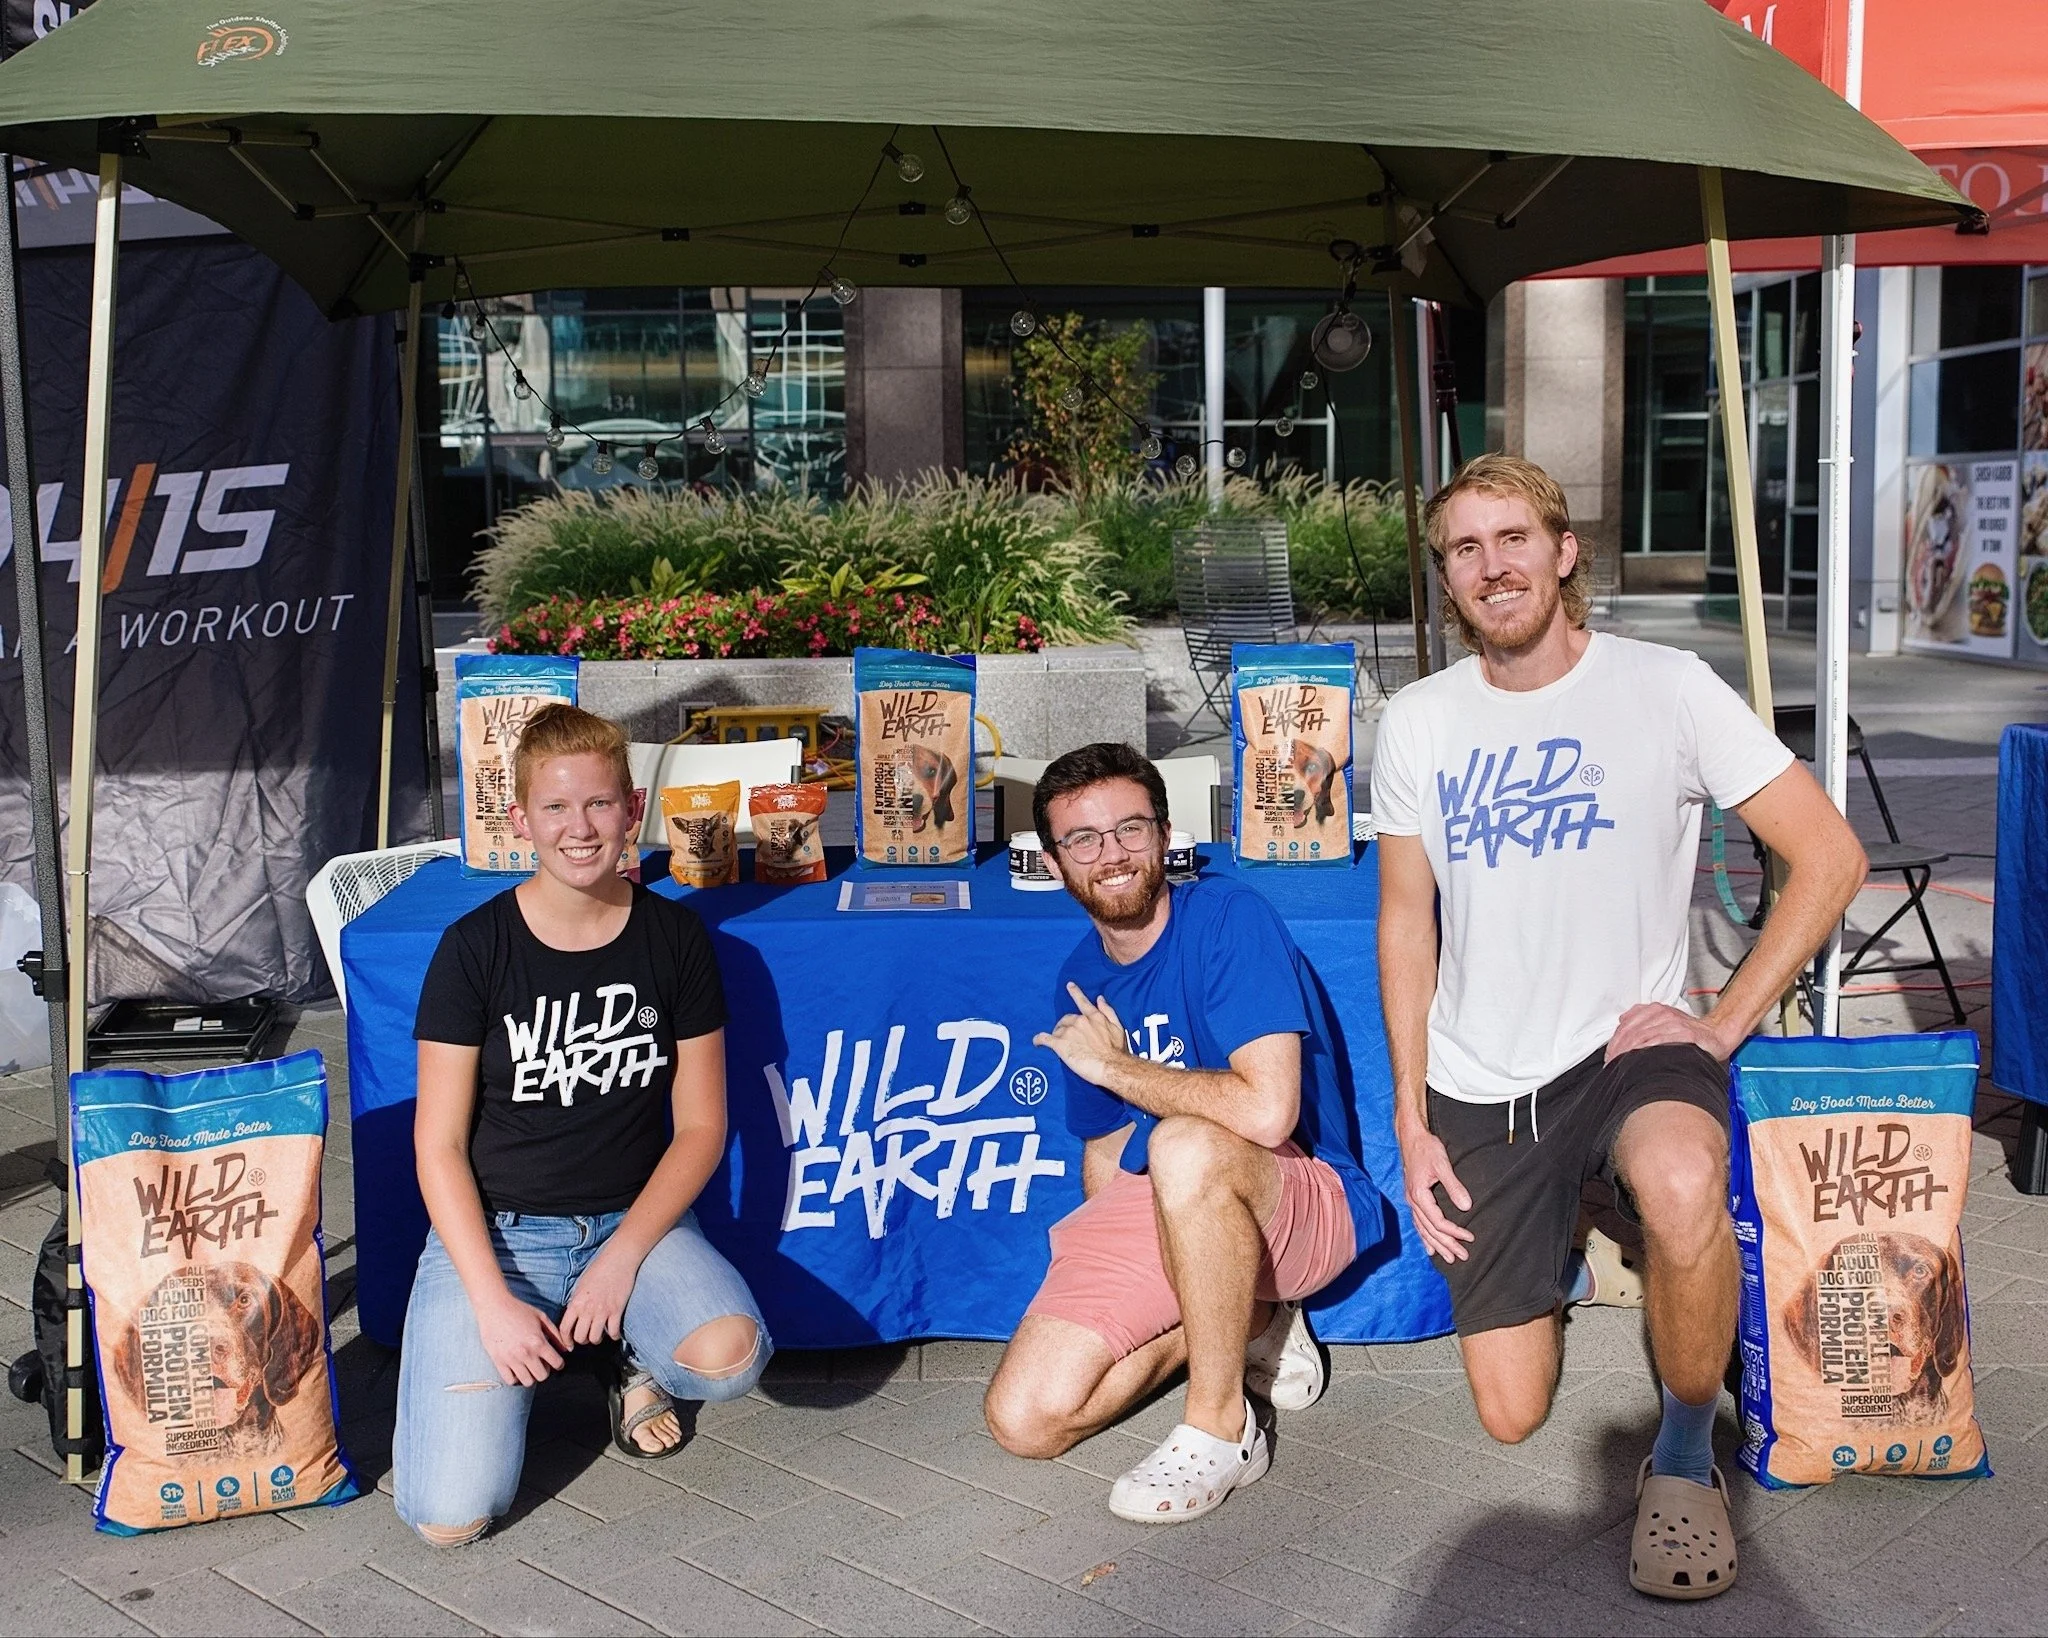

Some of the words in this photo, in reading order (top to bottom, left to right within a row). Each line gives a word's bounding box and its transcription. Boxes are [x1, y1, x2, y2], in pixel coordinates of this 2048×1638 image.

[219, 16, 253, 25] Outdoor
[255, 16, 281, 31] Shelter
[120, 594, 354, 649] WORKOUT
[879, 680, 893, 689] Dog
[1257, 676, 1271, 685] Dog
[482, 695, 539, 726] WILD
[880, 690, 938, 719] WILD
[1258, 685, 1317, 716] WILD
[881, 713, 951, 742] EARTH
[1262, 708, 1330, 737] EARTH
[874, 761, 884, 808] FORMULA
[884, 761, 896, 809] PROTEIN
[1255, 757, 1265, 803] FORMULA
[1265, 757, 1277, 804] PROTEIN
[1437, 737, 1582, 818] WILD
[1445, 792, 1615, 868] EARTH
[503, 983, 637, 1063] WILD
[512, 1033, 668, 1107] EARTH
[763, 1018, 1010, 1148] WILD
[1791, 1097, 1819, 1114] Dog
[1820, 1095, 1855, 1110] Food
[1856, 1094, 1894, 1109] Made
[1896, 1094, 1936, 1110] Better
[128, 1131, 158, 1148] Dog
[160, 1132, 192, 1148] Food
[193, 1128, 231, 1146] Made
[233, 1121, 272, 1138] Better
[1798, 1123, 1911, 1183] WILD
[133, 1152, 246, 1218] WILD
[780, 1115, 1065, 1240] EARTH
[1813, 1166, 1948, 1226] EARTH
[140, 1191, 279, 1260] EARTH
[1860, 1232, 1877, 1243] ALL
[1837, 1255, 1880, 1271] ADULT
[1842, 1243, 1879, 1255] BREEDS
[187, 1266, 204, 1277] ALL
[1818, 1271, 1844, 1286] DOG
[1847, 1270, 1883, 1285] FOOD
[161, 1288, 205, 1305] ADULT
[141, 1307, 168, 1323] DOG
[171, 1303, 206, 1320] FOOD
[1819, 1292, 1845, 1384] FORMULA
[1841, 1292, 1870, 1385] PROTEIN
[1866, 1291, 1891, 1384] COMPLETE
[141, 1329, 168, 1424] FORMULA
[163, 1325, 193, 1421] PROTEIN
[188, 1324, 216, 1420] COMPLETE
[1841, 1395, 1892, 1405] SUPERFOOD
[1871, 1385, 1892, 1394] WITH
[1841, 1404, 1892, 1413] INGREDIENTS
[165, 1429, 217, 1443] SUPERFOOD
[196, 1419, 217, 1430] WITH
[166, 1438, 218, 1451] INGREDIENTS
[1835, 1450, 1856, 1462] 31%
[162, 1487, 184, 1499] 31%
[271, 1486, 296, 1495] PLANT
